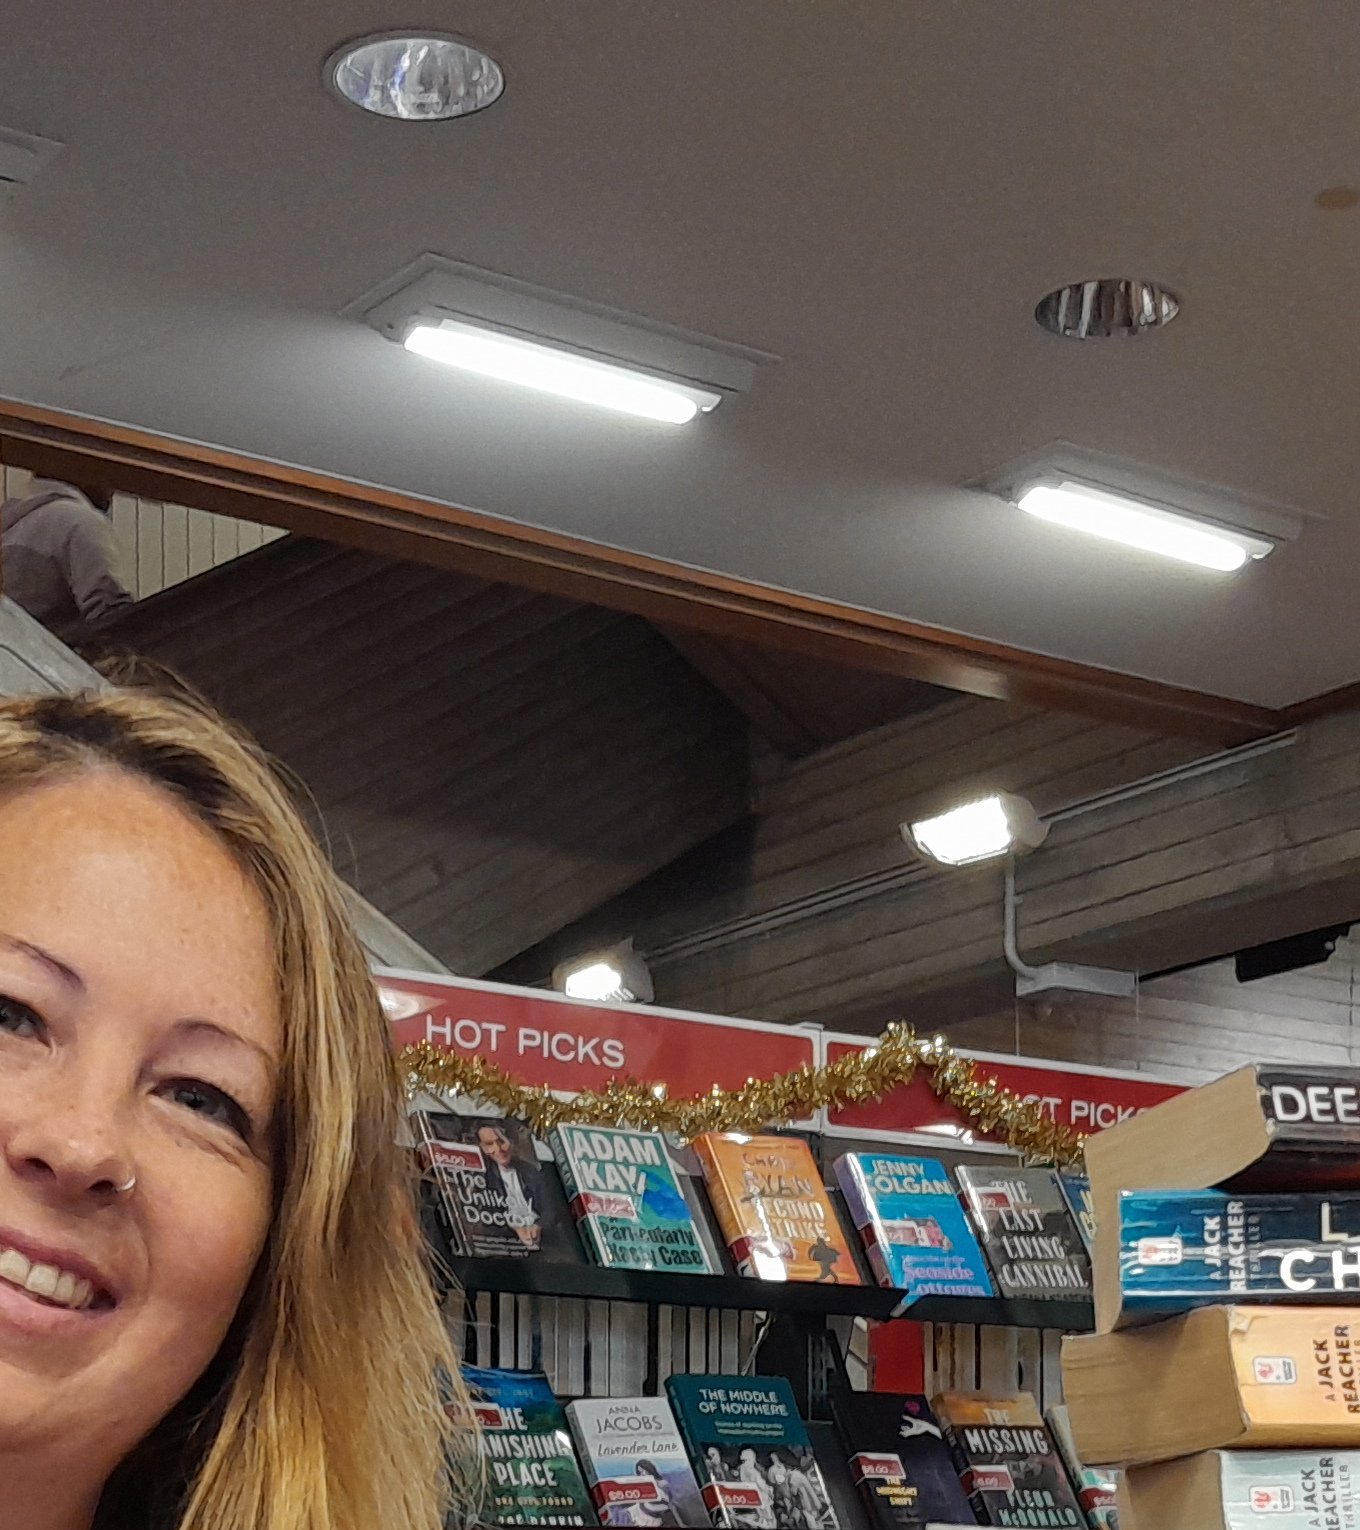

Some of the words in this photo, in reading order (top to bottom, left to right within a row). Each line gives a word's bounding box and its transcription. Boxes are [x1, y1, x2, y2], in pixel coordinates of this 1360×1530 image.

[426, 1014, 506, 1051] HOT
[518, 1027, 625, 1069] PICKS
[571, 1129, 662, 1167] ADAM
[448, 1169, 487, 1189] The
[581, 1161, 646, 1196] KAY
[872, 1159, 925, 1177] JENNY
[464, 1204, 536, 1228] Doctor
[998, 1207, 1045, 1232] LAST
[1203, 1215, 1222, 1268] JACK
[1226, 1201, 1246, 1291] REACHER
[658, 1247, 704, 1267] Case
[1313, 1337, 1331, 1385] JACK
[699, 1388, 727, 1403] THE
[728, 1389, 778, 1404] MIDDLE
[1326, 1388, 1337, 1402] A
[698, 1401, 718, 1414] OF
[720, 1402, 790, 1417] NOWHERE
[596, 1415, 664, 1434] JACOBS
[964, 1428, 1049, 1455] MISSING
[493, 1462, 558, 1487] PLACE
[1294, 1468, 1317, 1511] JACK
[1309, 1514, 1321, 1528] A
